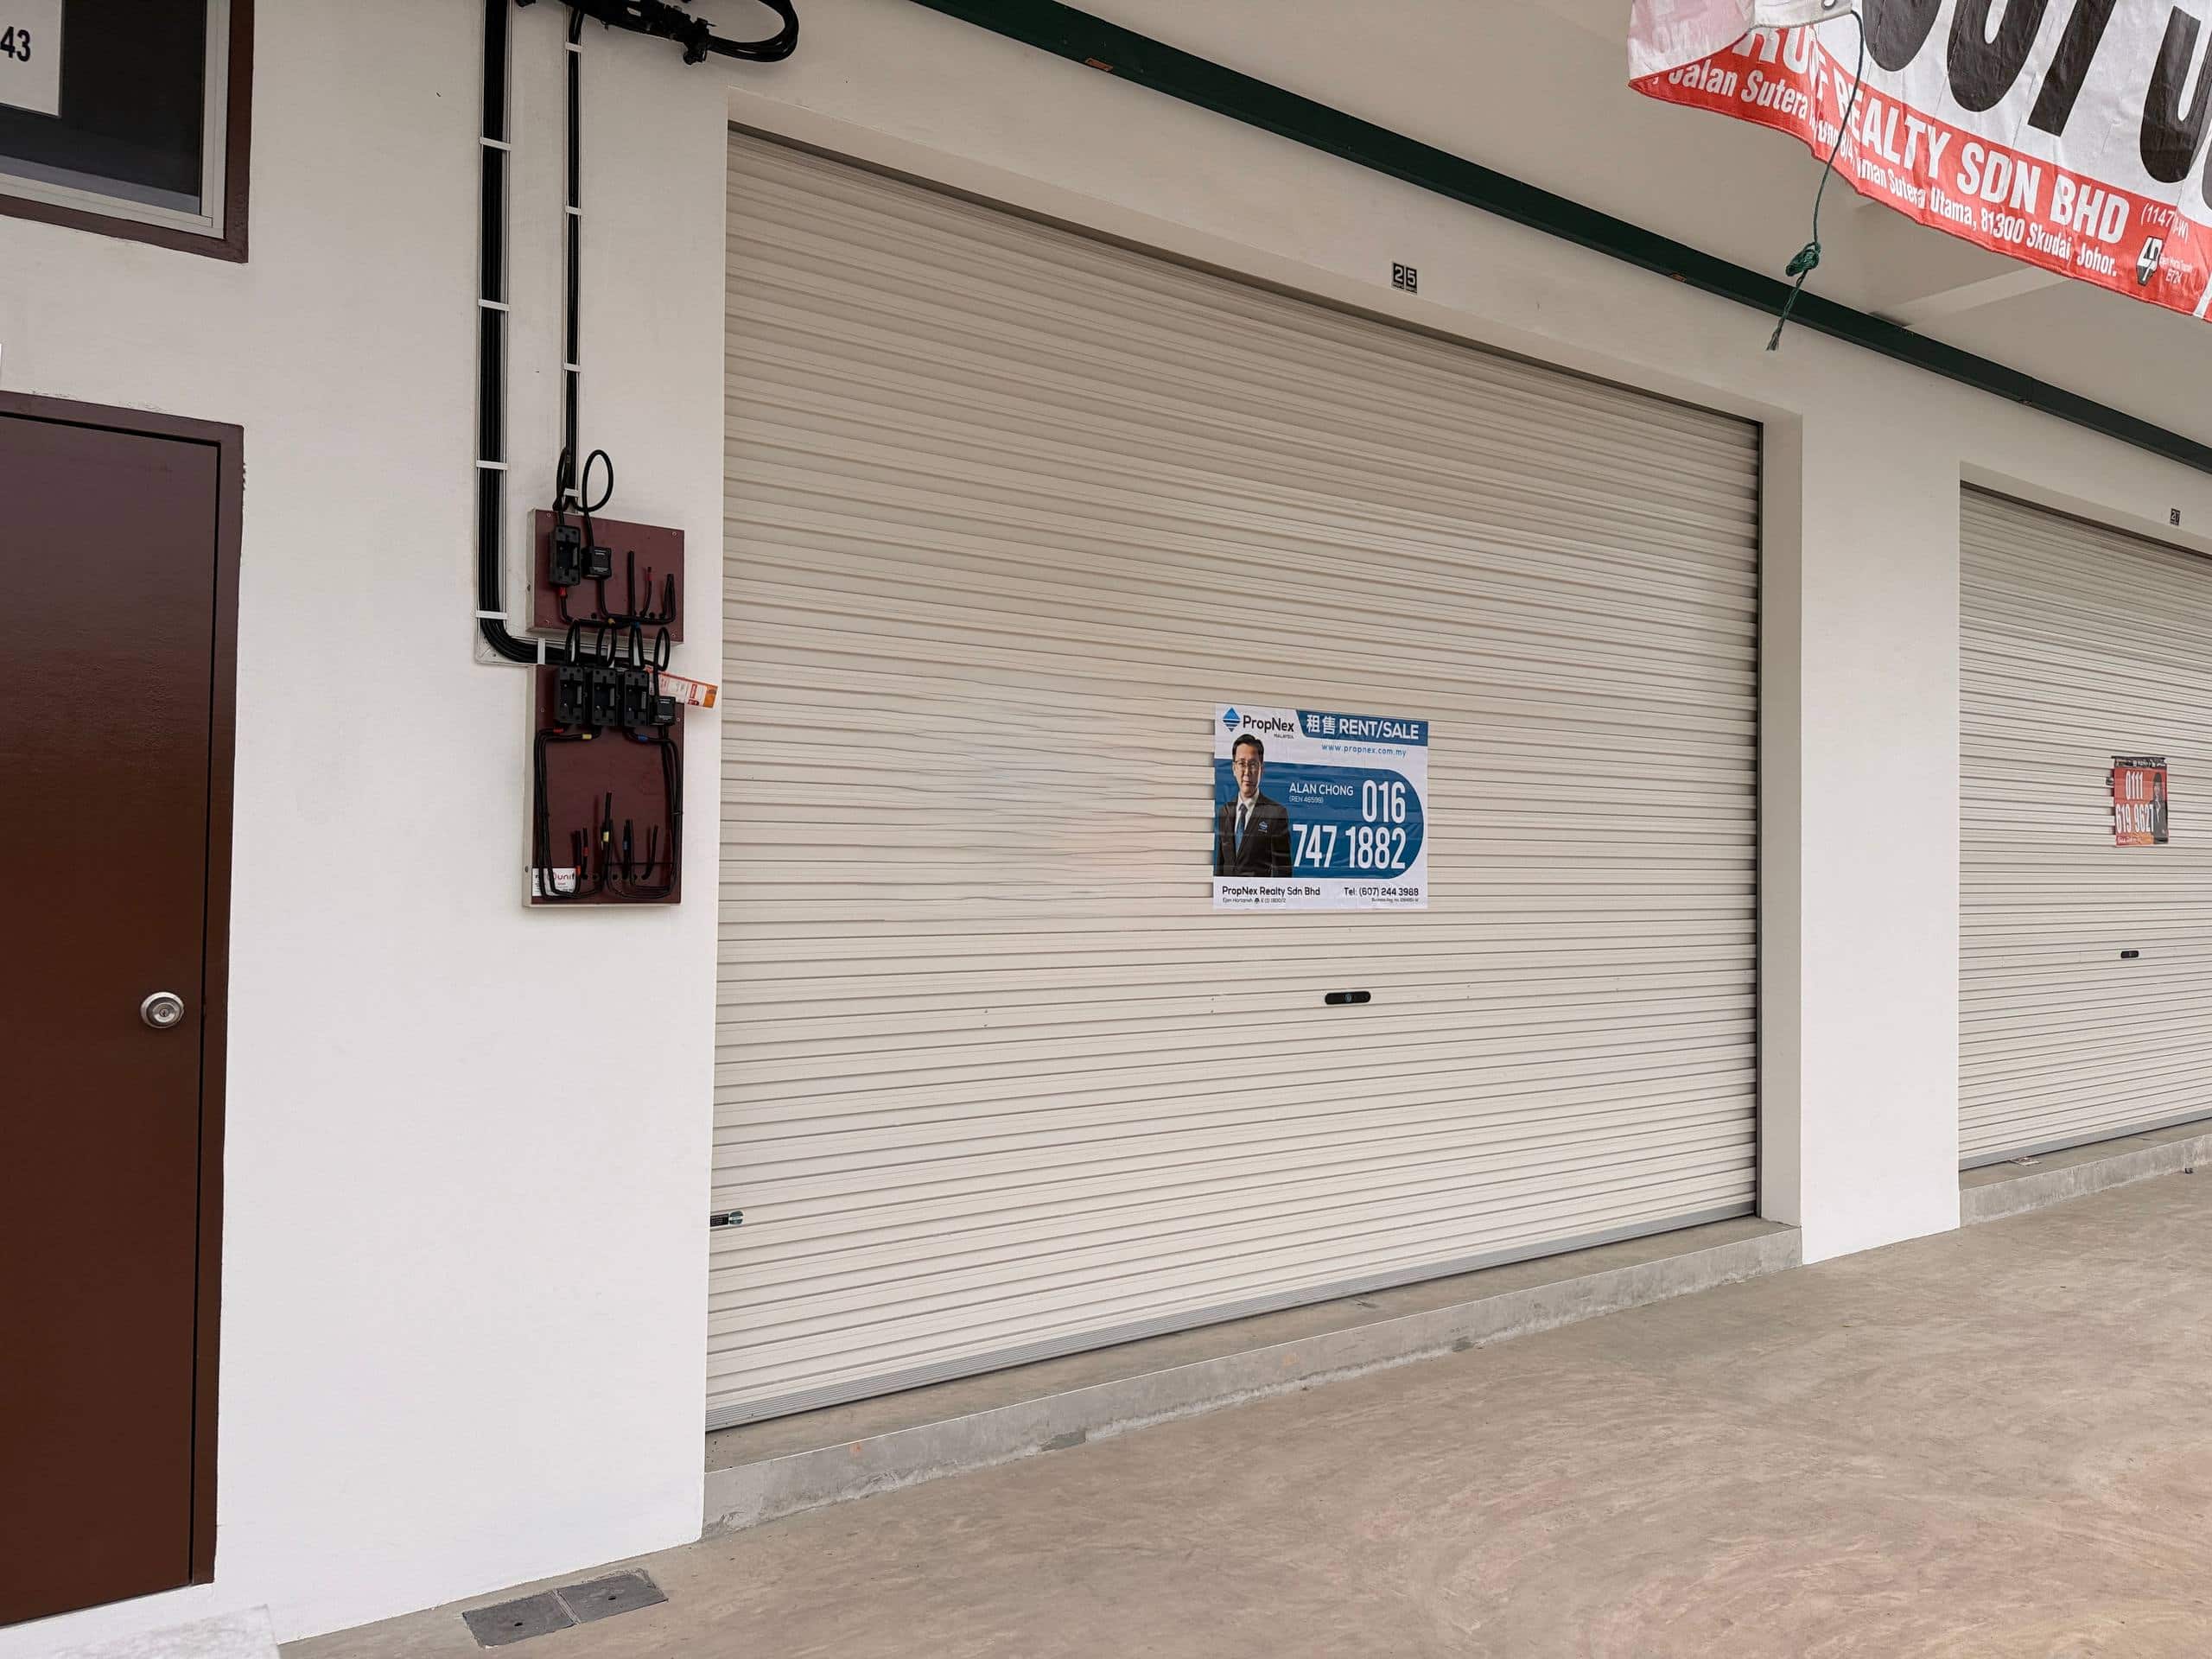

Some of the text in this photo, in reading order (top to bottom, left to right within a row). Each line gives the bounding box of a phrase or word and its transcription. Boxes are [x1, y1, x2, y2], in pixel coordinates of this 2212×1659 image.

[0, 26, 30, 62] 43
[1741, 69, 1808, 120] Sutera
[1833, 66, 1951, 180] REALTY
[1957, 142, 2042, 215] SDN
[2050, 175, 2130, 245] BHD
[1887, 168, 1928, 209] Sutera
[1930, 186, 1977, 231] Utama,
[1980, 207, 2026, 244] 81300
[2076, 242, 2118, 277] Johor.
[1395, 265, 1416, 286] 25
[1243, 715, 1294, 733] PropNex
[1338, 718, 1420, 740] RENT/SALE
[1321, 744, 1407, 758] www.propnex.com.my
[1289, 782, 1354, 796] ALAN CHONG
[1362, 779, 1406, 823] 016
[2126, 770, 2144, 801] 0111
[2115, 803, 2154, 834] 619 9627
[1292, 823, 1407, 869] 747 1882
[1222, 886, 1321, 898] PropNex Realty Sdn Bhd
[1359, 887, 1379, 897] (607)
[1381, 887, 1397, 896] 244
[1398, 887, 1419, 896] 3988
